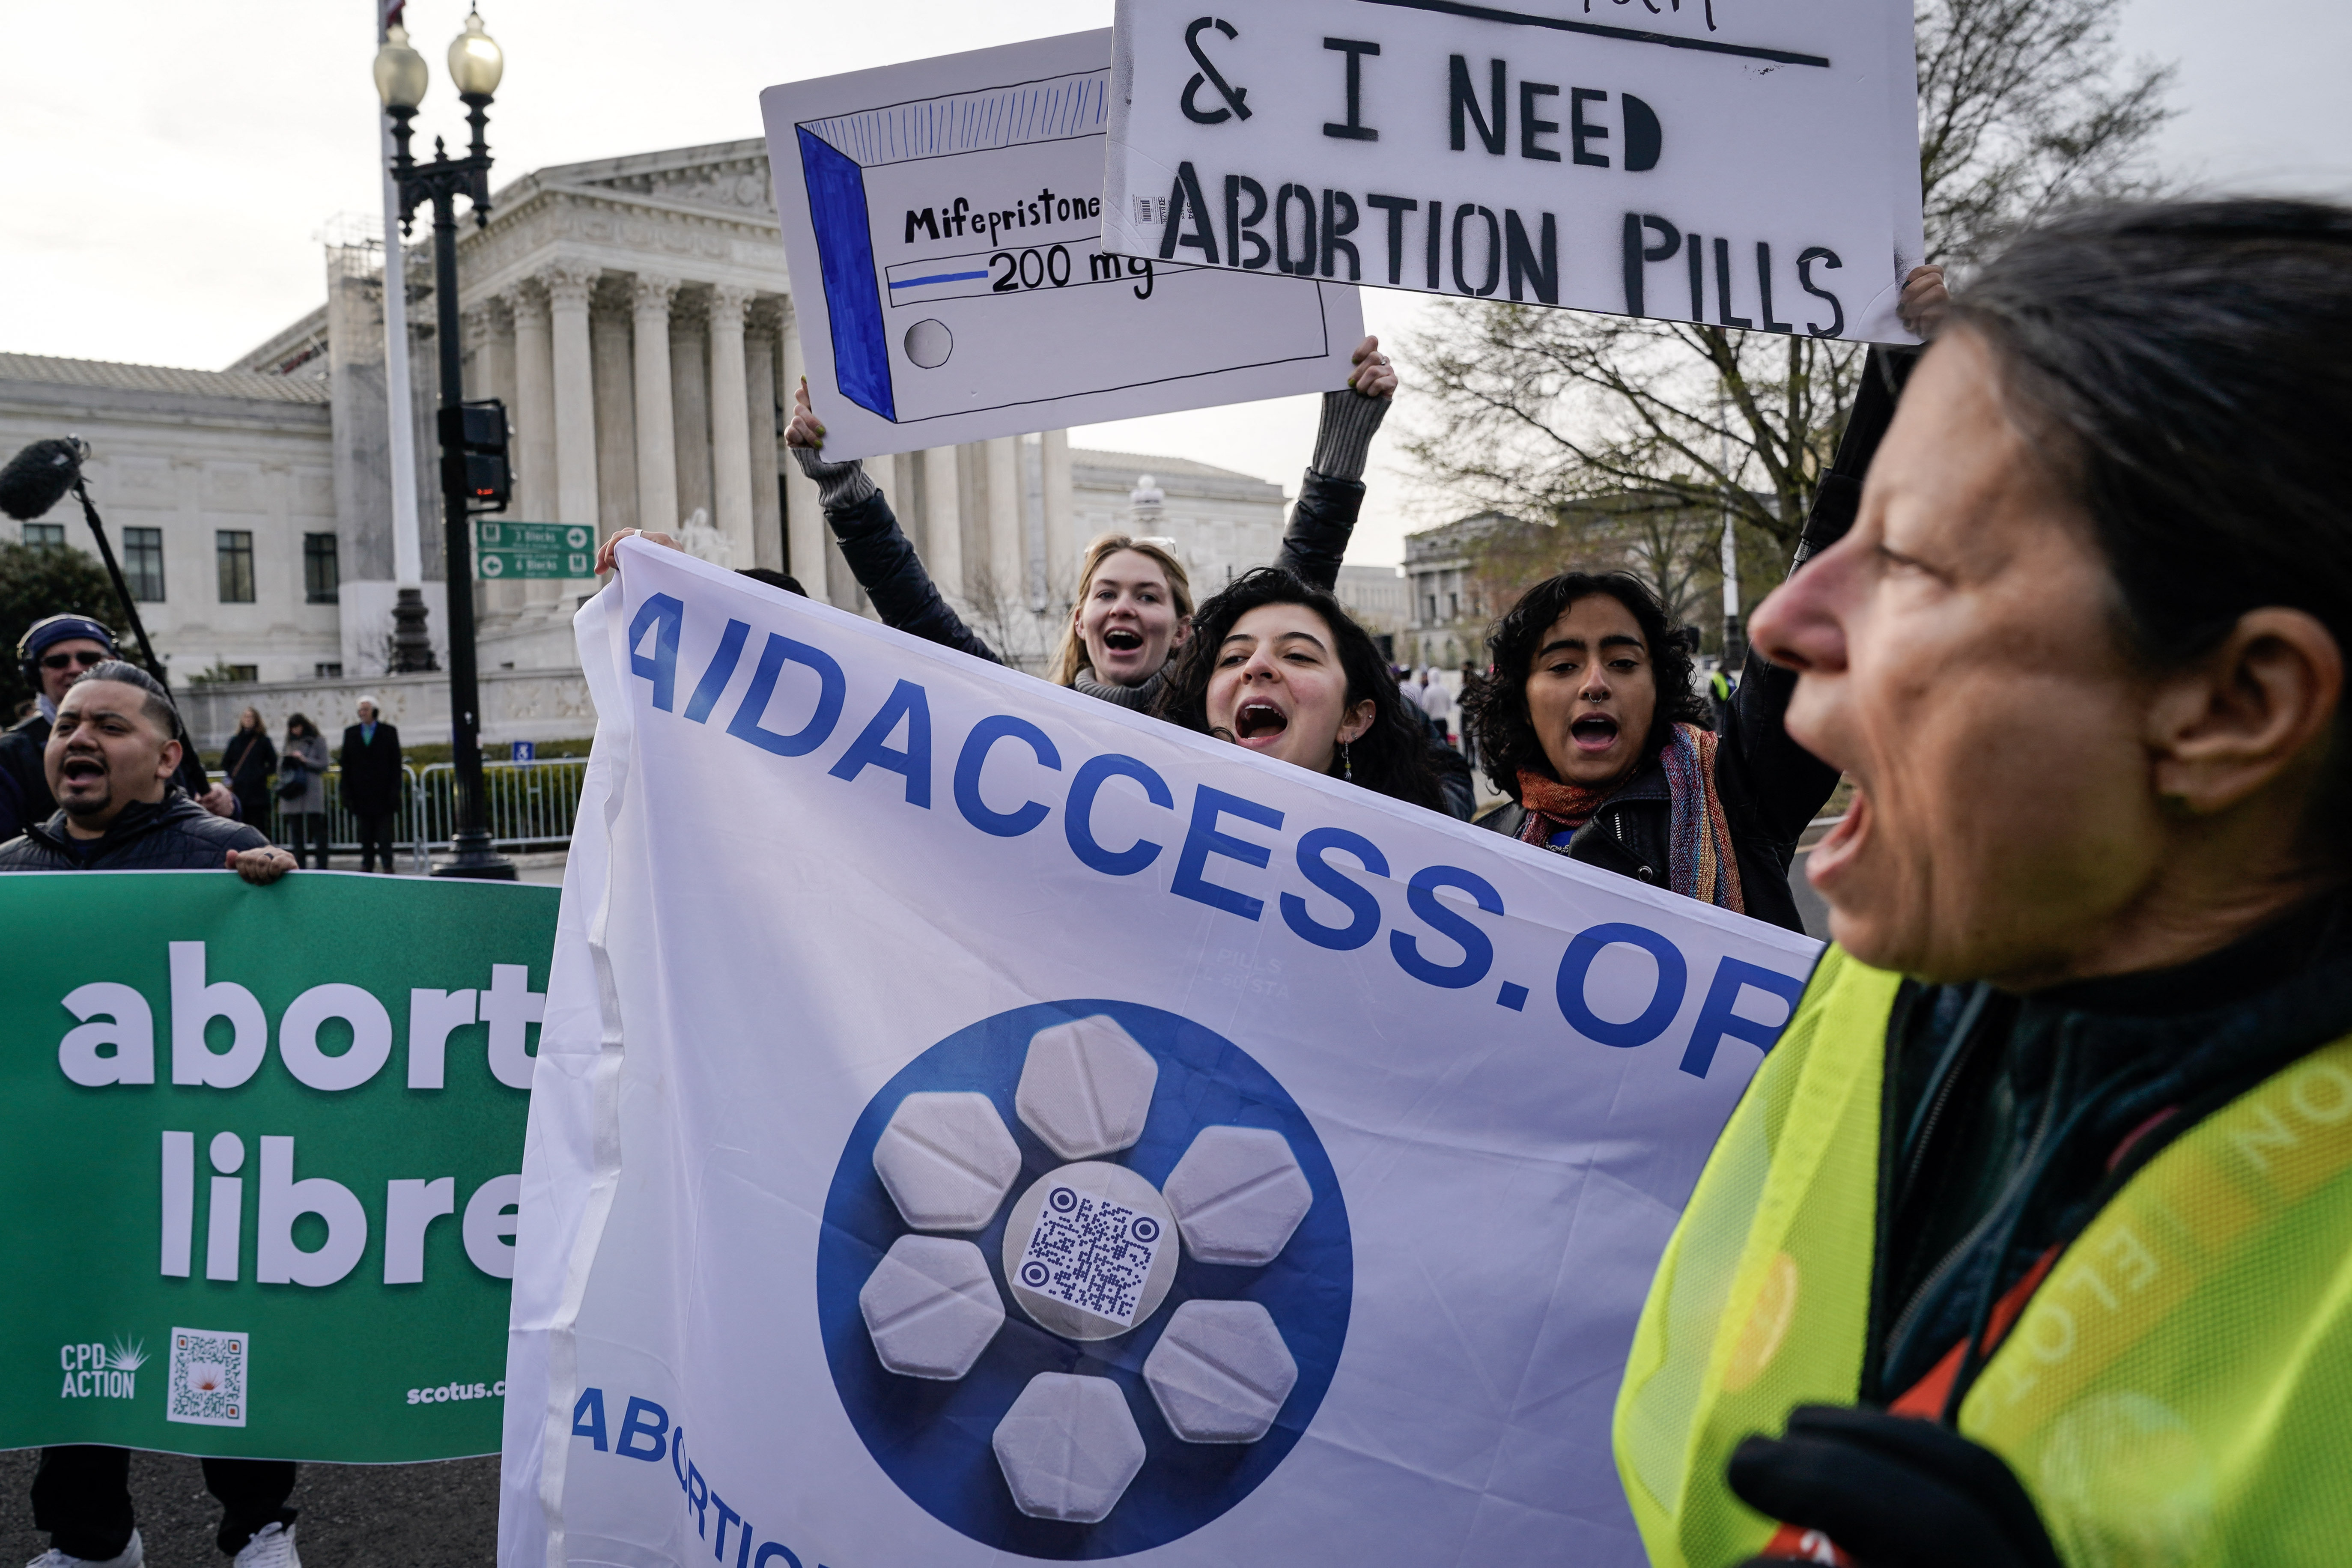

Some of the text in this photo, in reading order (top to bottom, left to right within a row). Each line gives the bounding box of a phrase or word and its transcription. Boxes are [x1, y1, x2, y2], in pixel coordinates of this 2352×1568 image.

[1180, 16, 1663, 173] & I NEED
[904, 188, 1100, 247] Mifepristone
[988, 244, 1154, 300] 200 mg
[1158, 160, 1844, 341] ABORTION PILLS
[59, 940, 546, 1091] abort
[160, 1130, 522, 1287] libre
[61, 1343, 105, 1371] CPD
[61, 1371, 135, 1400] ACTION
[406, 1380, 505, 1405] scotus.c
